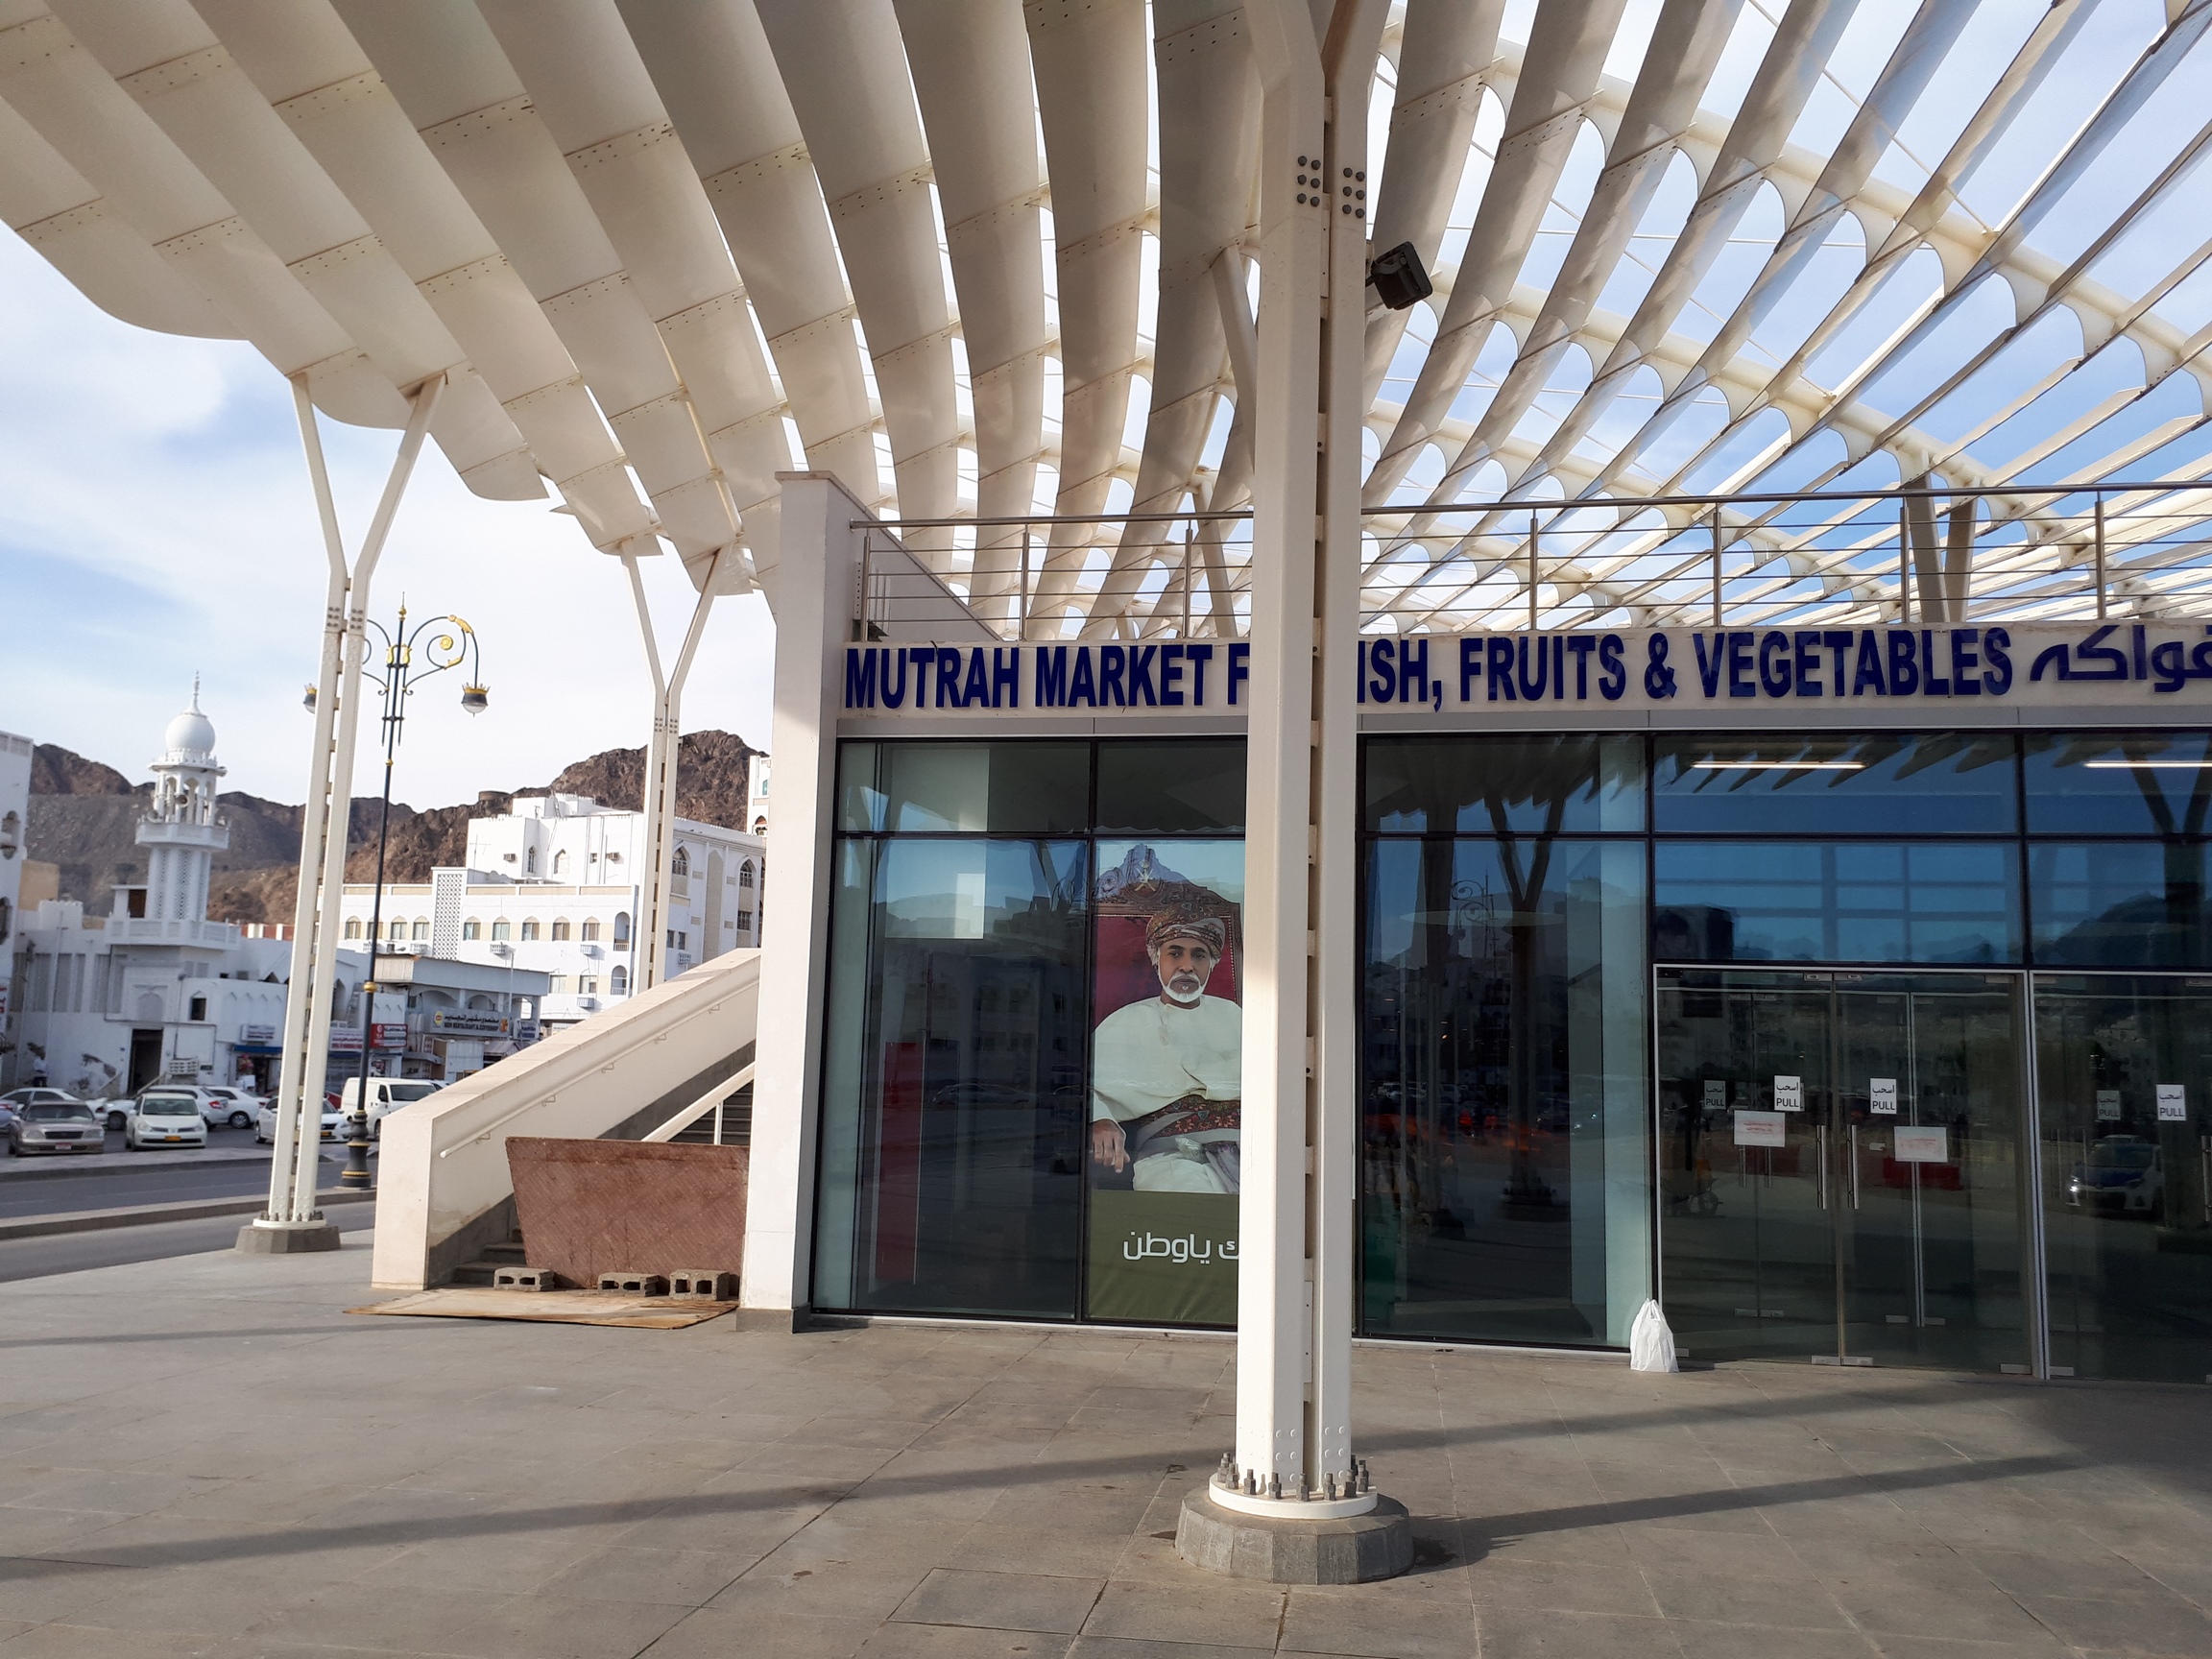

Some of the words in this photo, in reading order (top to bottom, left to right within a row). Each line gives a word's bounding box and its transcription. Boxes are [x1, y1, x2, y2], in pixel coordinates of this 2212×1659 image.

[845, 647, 1021, 709] MUTRAH
[1035, 643, 1213, 708] MARKET
[1357, 637, 1443, 713] ISH,
[1459, 634, 1627, 702] FRUITS
[1643, 633, 1678, 700] &
[1692, 626, 2012, 699] VEGETABLES
[1705, 1098, 1724, 1107] PULL
[1776, 1097, 1800, 1108] PULL
[1872, 1100, 1895, 1111] PULL
[2100, 1109, 2120, 1118] PULL
[2159, 1107, 2185, 1118] PULL
